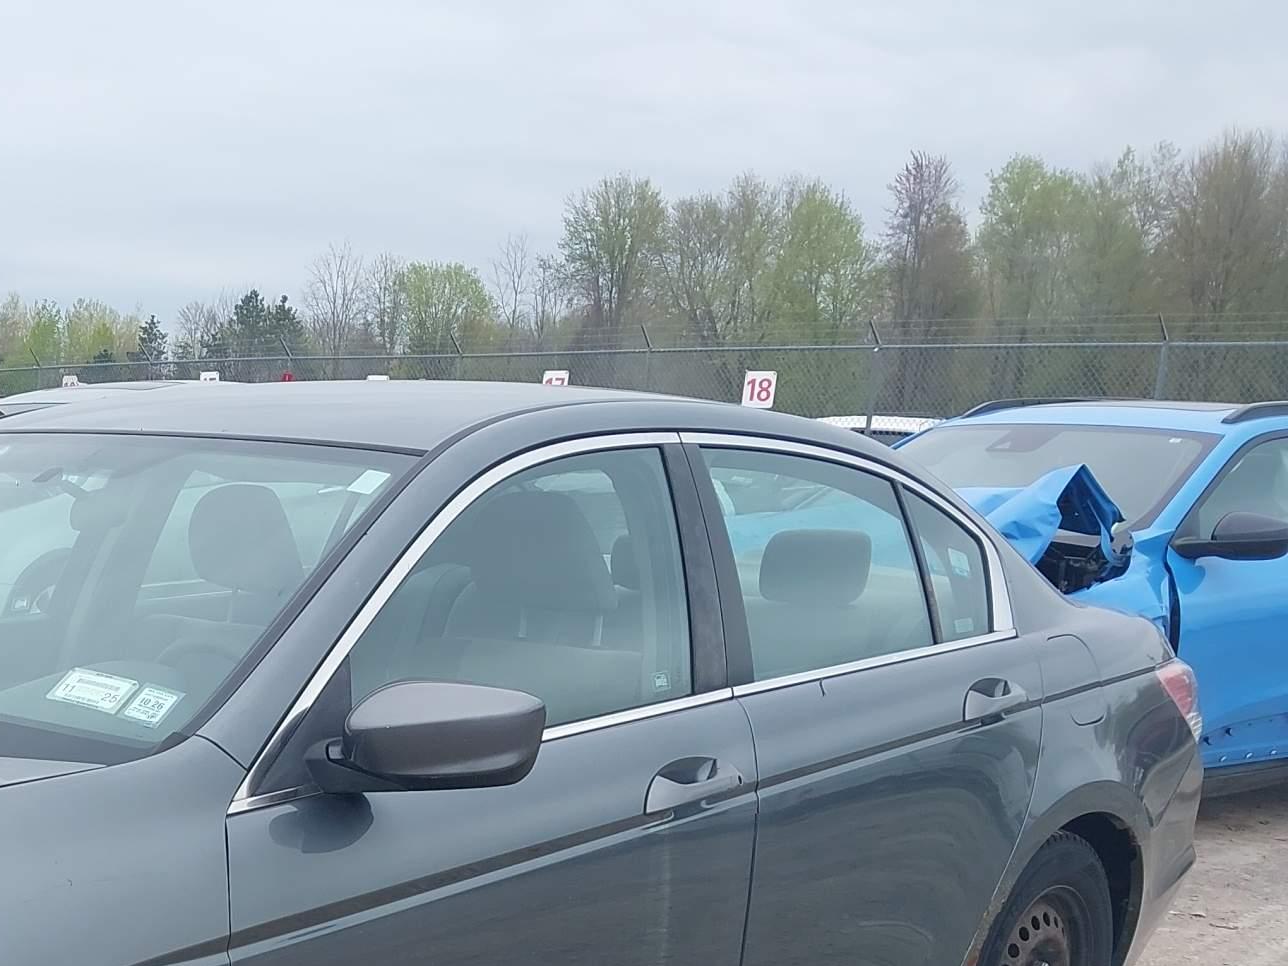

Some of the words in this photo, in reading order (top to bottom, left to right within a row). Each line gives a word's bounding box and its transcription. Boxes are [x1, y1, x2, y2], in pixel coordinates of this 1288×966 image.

[746, 378, 772, 402] 18
[62, 683, 76, 693] 11
[101, 692, 120, 703] 25
[140, 697, 152, 706] 10
[151, 700, 165, 711] 26
